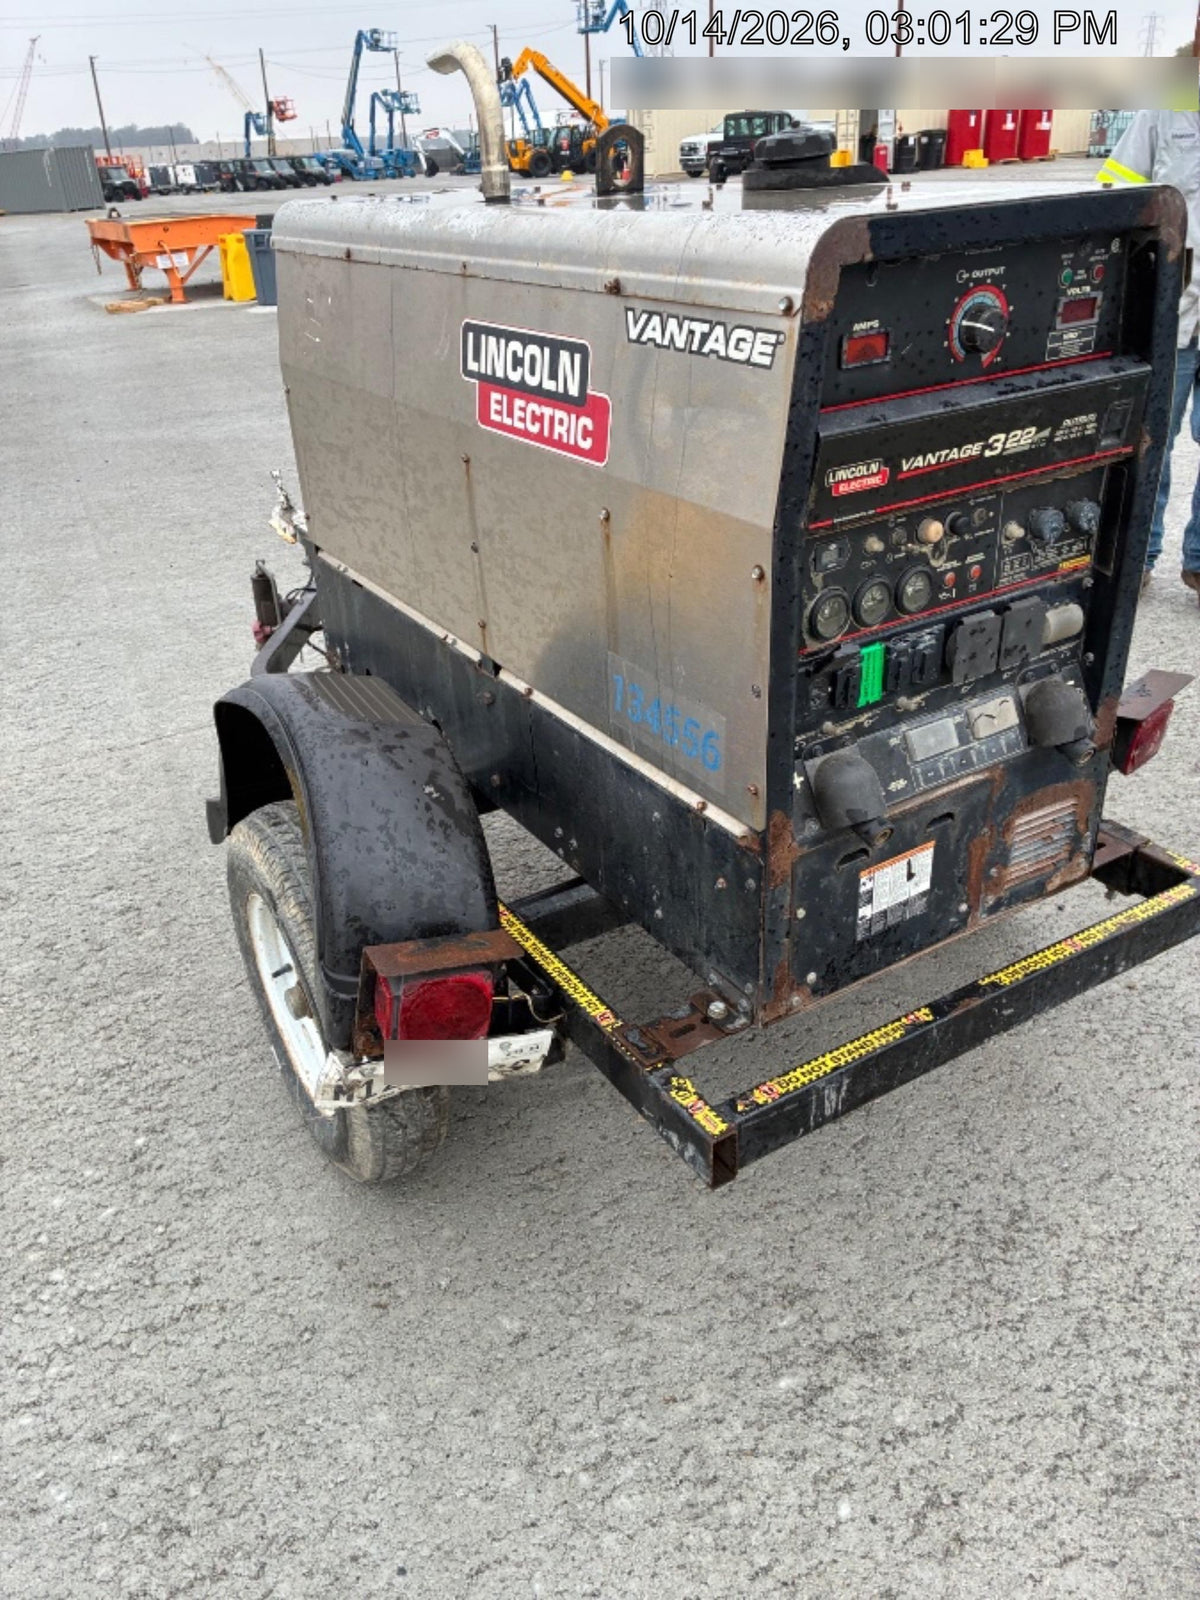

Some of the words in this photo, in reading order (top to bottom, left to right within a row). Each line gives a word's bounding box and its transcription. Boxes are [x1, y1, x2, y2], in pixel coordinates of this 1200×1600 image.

[971, 266, 1006, 278] OUTPUT
[625, 308, 779, 367] VANTAGE
[466, 331, 582, 397] LINCOLN
[489, 391, 594, 450] ELECTRIC
[828, 461, 880, 483] LINCOLN
[901, 442, 984, 472] VANTAGE
[983, 426, 1038, 458] 322
[838, 475, 883, 493] ELECTRIC
[612, 674, 722, 772] 134556
[552, 965, 590, 999] DEBOUT
[776, 1076, 800, 1090] DO
[799, 1060, 830, 1078] NOT
[830, 1039, 876, 1064] STAND
